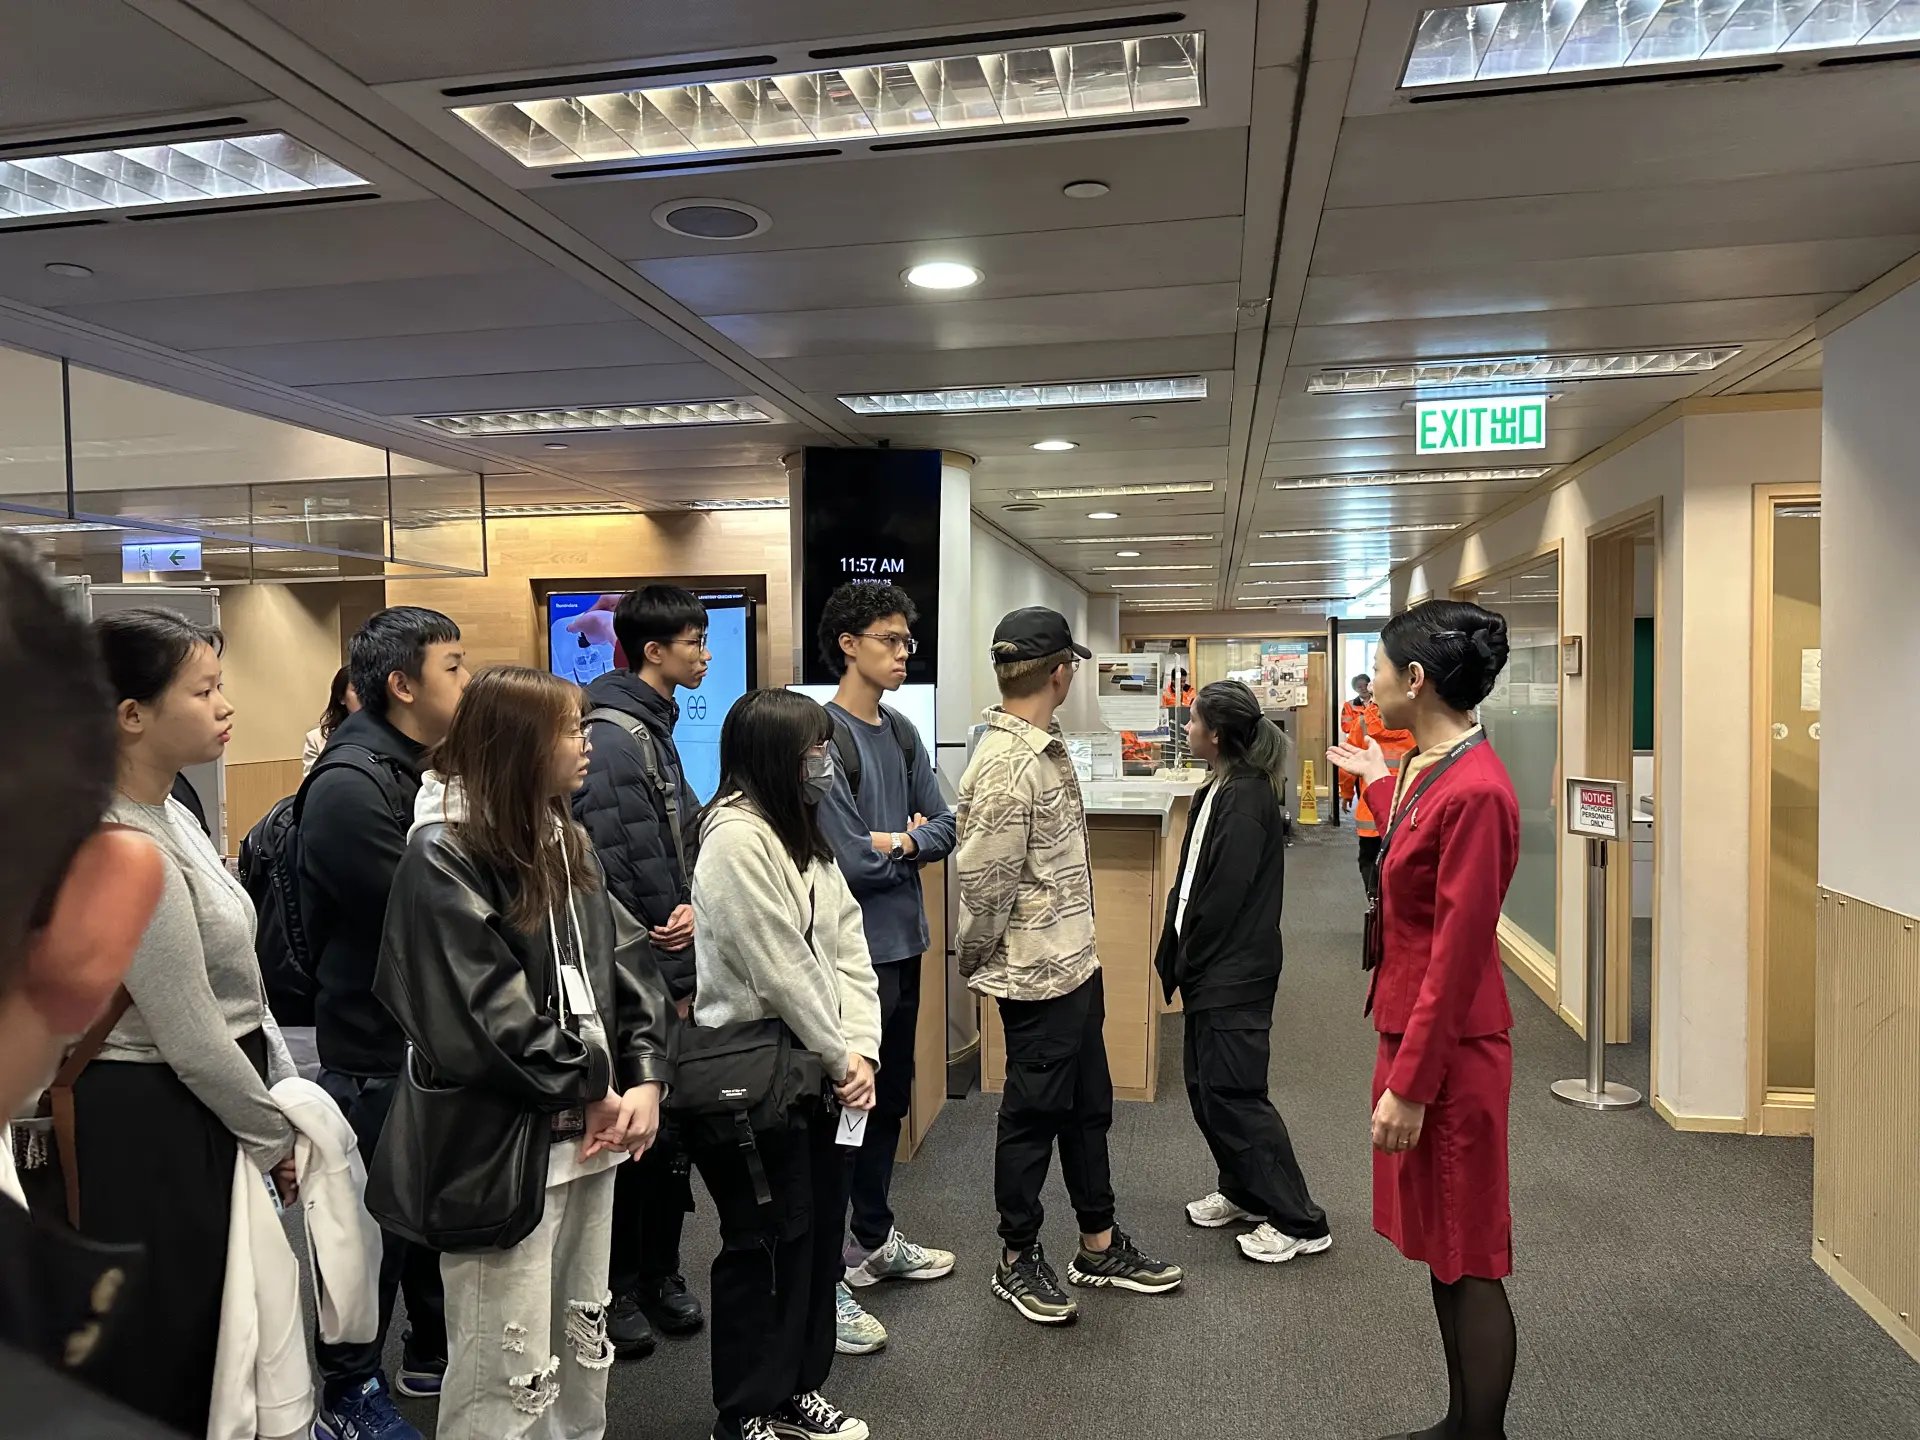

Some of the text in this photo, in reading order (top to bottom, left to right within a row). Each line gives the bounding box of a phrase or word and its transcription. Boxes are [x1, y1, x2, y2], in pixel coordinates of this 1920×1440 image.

[1421, 407, 1488, 449] EXIT
[1490, 404, 1542, 445] 出口
[840, 557, 904, 573] 11:57 AM
[1582, 791, 1612, 805] NOTICE
[1581, 804, 1614, 814] AUTHORIZED
[1582, 811, 1614, 821] PERSONNEL
[1591, 819, 1605, 828] ONLY
